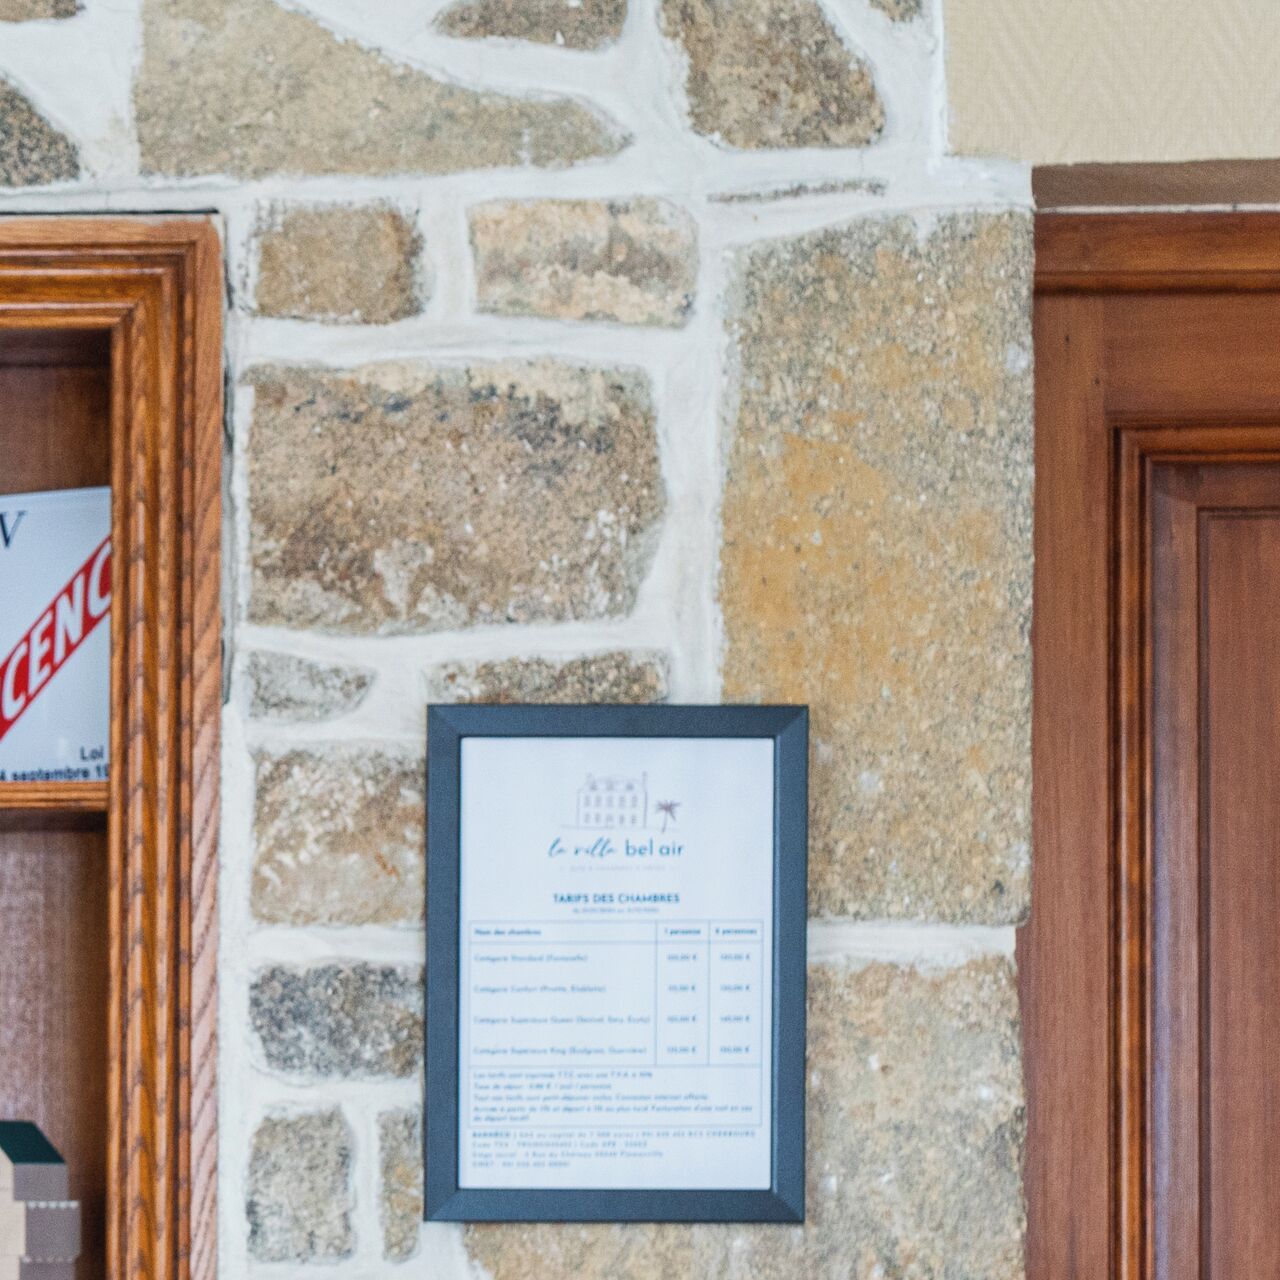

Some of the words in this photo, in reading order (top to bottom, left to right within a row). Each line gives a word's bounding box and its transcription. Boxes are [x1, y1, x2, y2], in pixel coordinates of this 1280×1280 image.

[80, 745, 104, 761] Loi
[12, 765, 90, 781] septembre
[548, 837, 567, 858] la
[573, 837, 618, 858] villa
[625, 837, 653, 856] bel
[659, 840, 684, 856] air
[553, 892, 589, 903] TARIFS
[593, 892, 614, 903] DES
[618, 892, 680, 903] CHAMBRES
